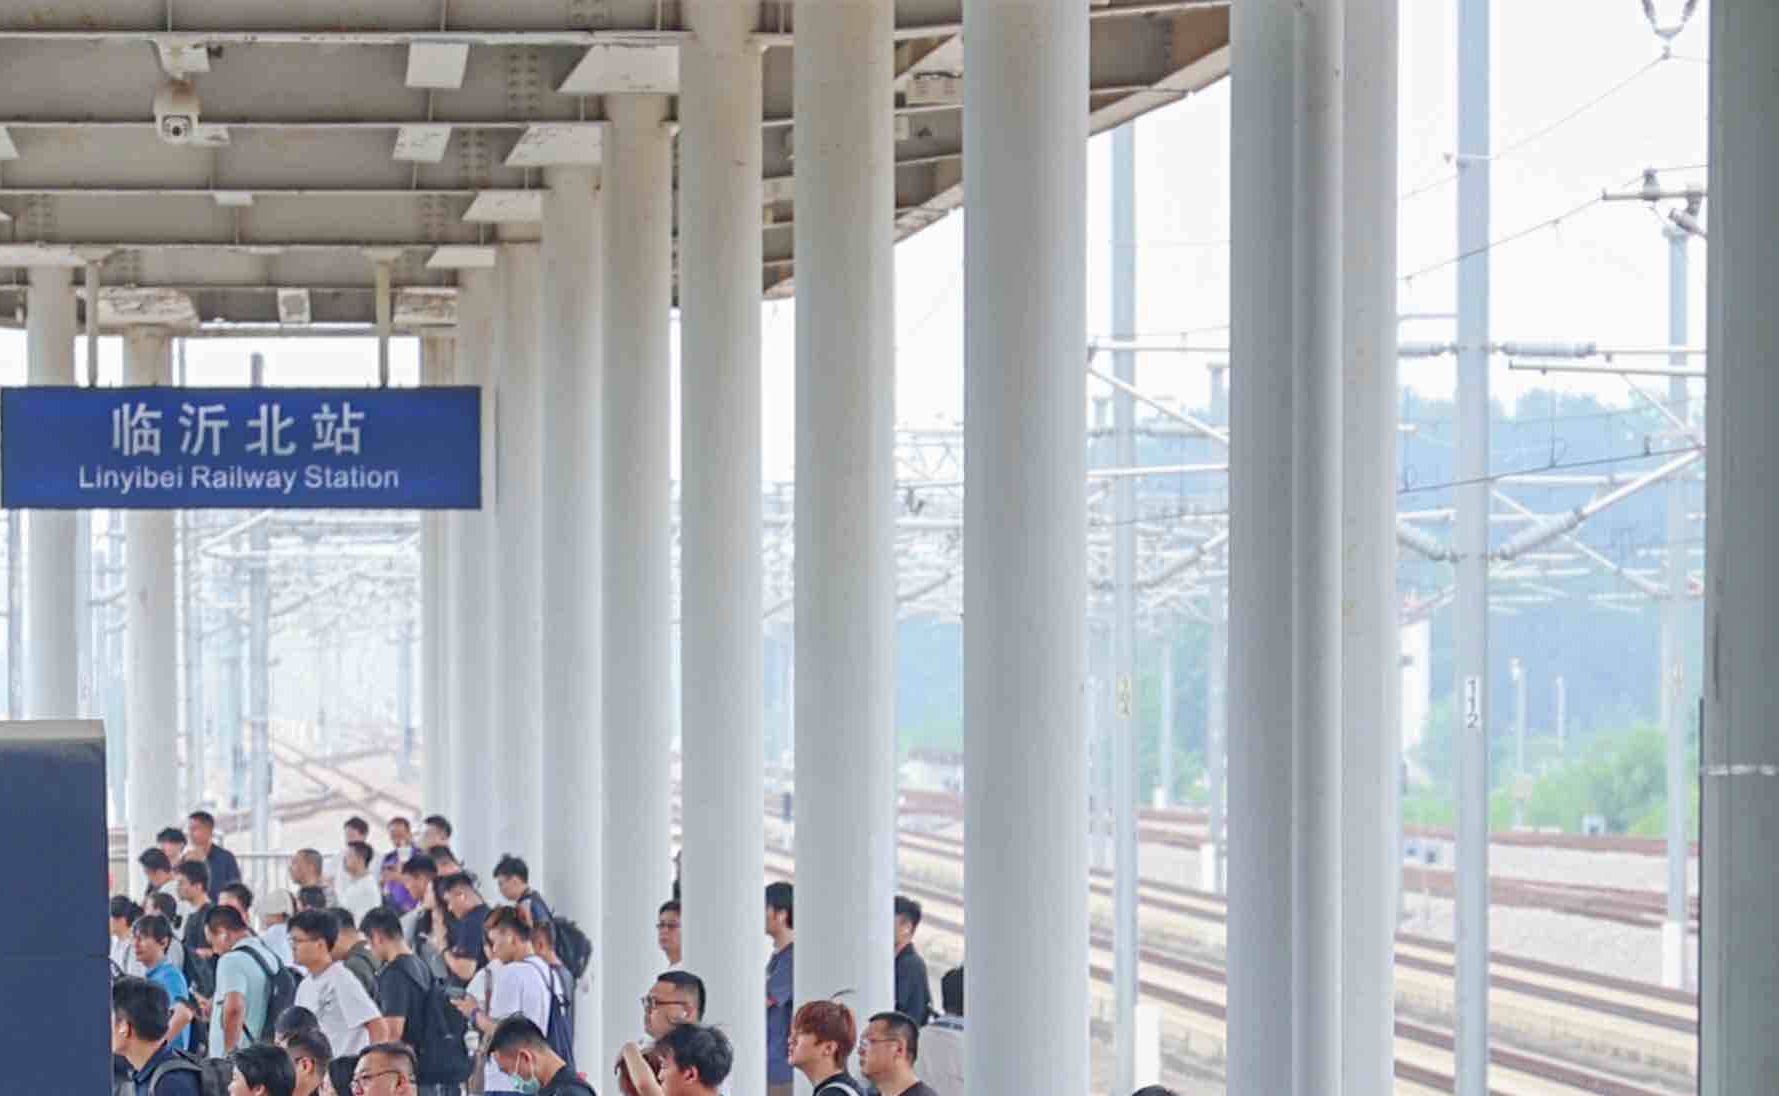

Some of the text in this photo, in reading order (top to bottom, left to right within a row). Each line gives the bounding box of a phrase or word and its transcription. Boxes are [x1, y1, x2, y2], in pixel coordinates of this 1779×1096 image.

[112, 402, 365, 456] 临沂北站
[79, 465, 399, 495] Linyibei Railway Station
